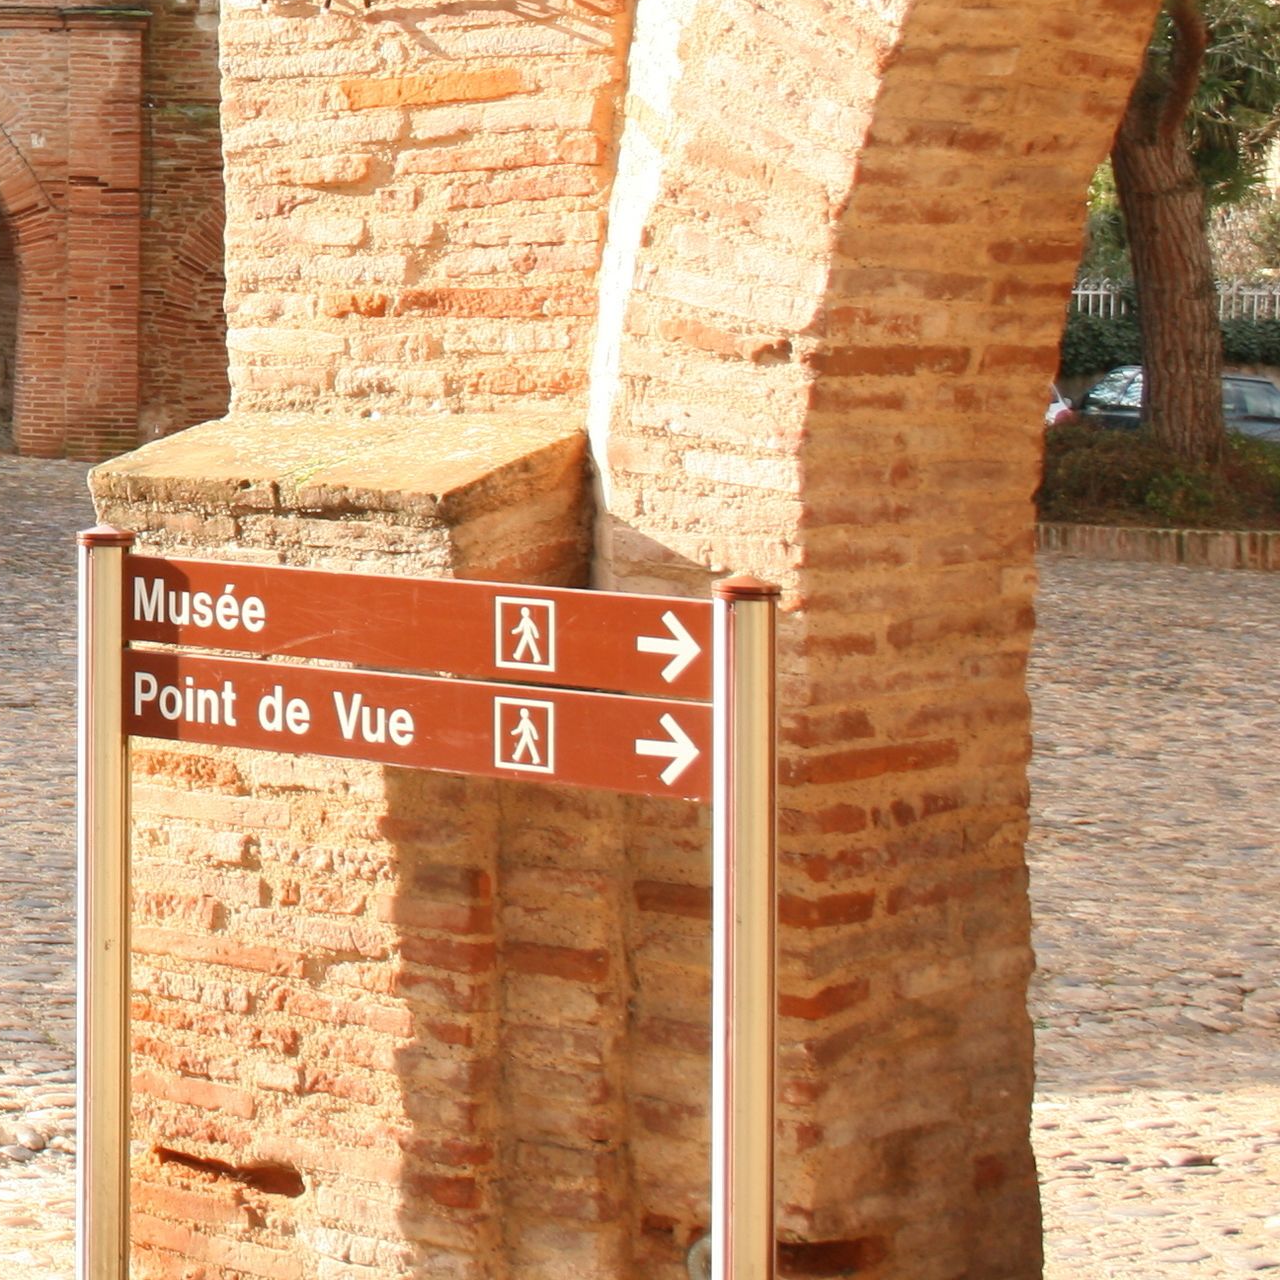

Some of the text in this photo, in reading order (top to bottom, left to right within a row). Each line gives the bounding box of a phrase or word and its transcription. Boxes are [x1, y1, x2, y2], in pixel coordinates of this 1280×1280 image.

[133, 575, 267, 633] Musée
[133, 671, 415, 747] Point de Vue
